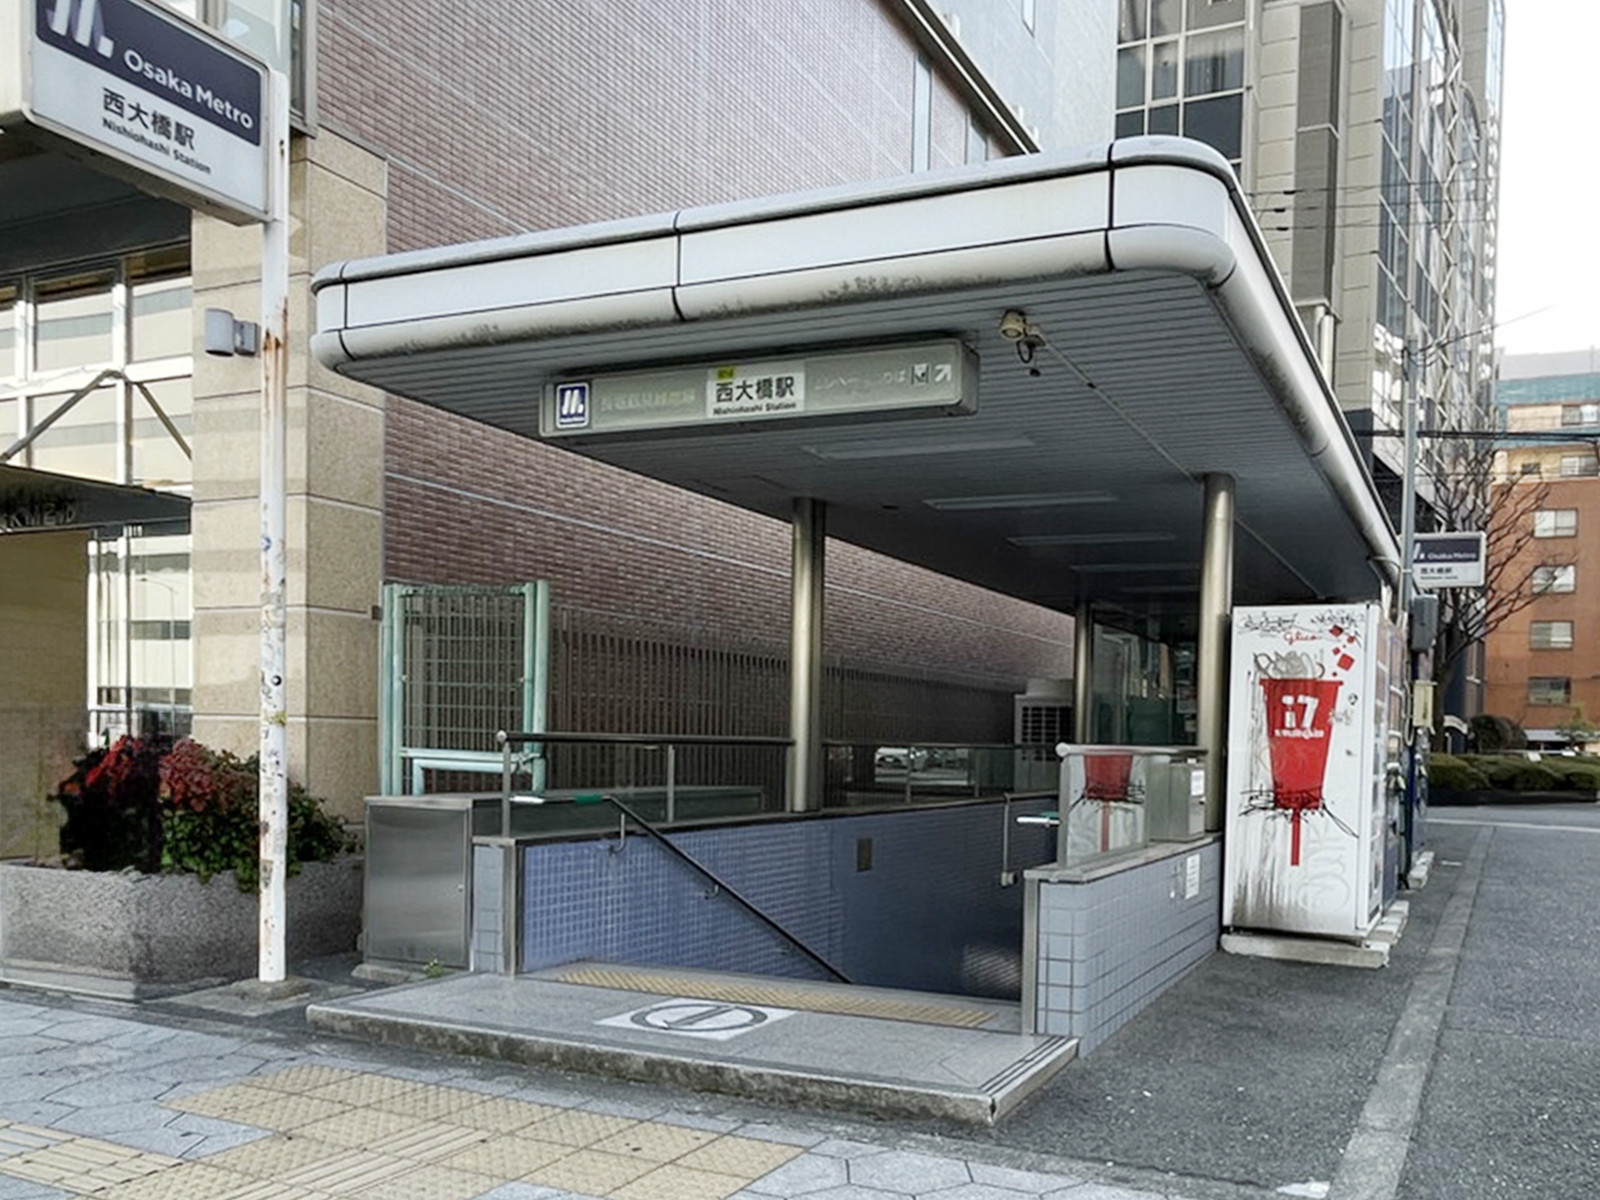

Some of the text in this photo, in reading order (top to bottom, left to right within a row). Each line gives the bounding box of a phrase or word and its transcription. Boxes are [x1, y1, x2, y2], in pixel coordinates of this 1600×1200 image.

[103, 87, 195, 150] 西大橋駅
[124, 49, 254, 129] Osaka Metro
[102, 117, 212, 175] Nishiohashi Station
[716, 376, 795, 403] 西大橋駅
